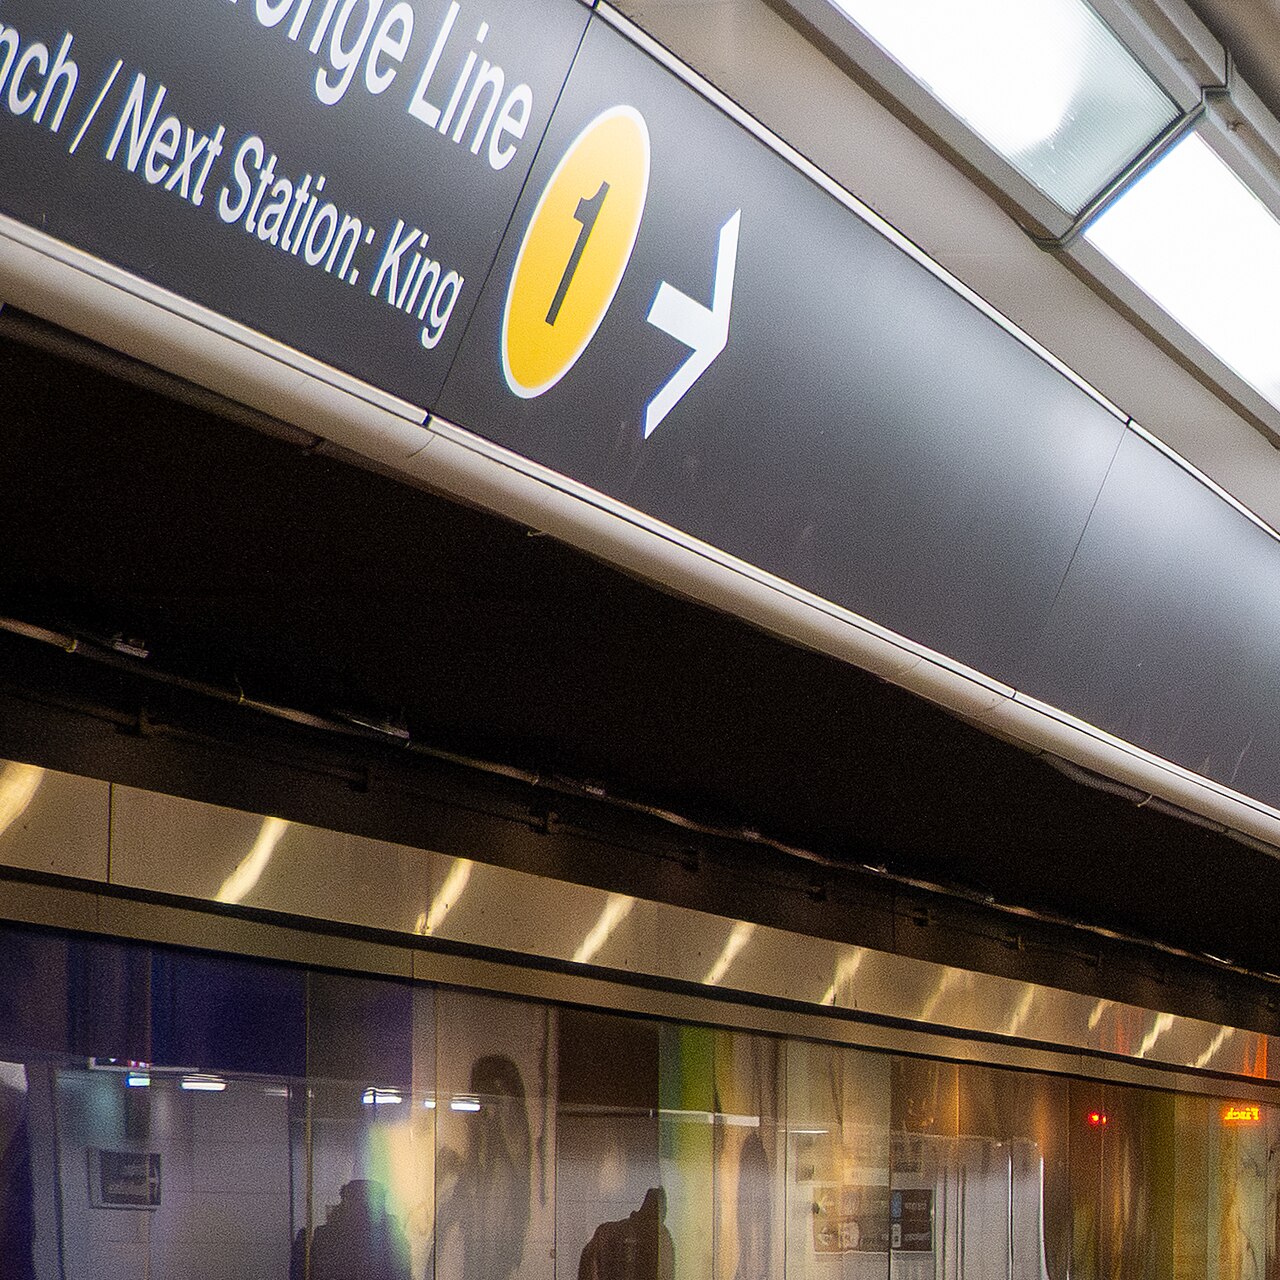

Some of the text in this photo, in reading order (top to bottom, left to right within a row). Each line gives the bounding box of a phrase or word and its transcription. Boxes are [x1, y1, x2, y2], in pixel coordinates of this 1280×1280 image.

[408, 0, 535, 171] Line
[68, 57, 124, 155] /
[105, 71, 226, 206] Next
[218, 135, 376, 285] Station:
[370, 218, 465, 350] King
[545, 182, 610, 327] 1
